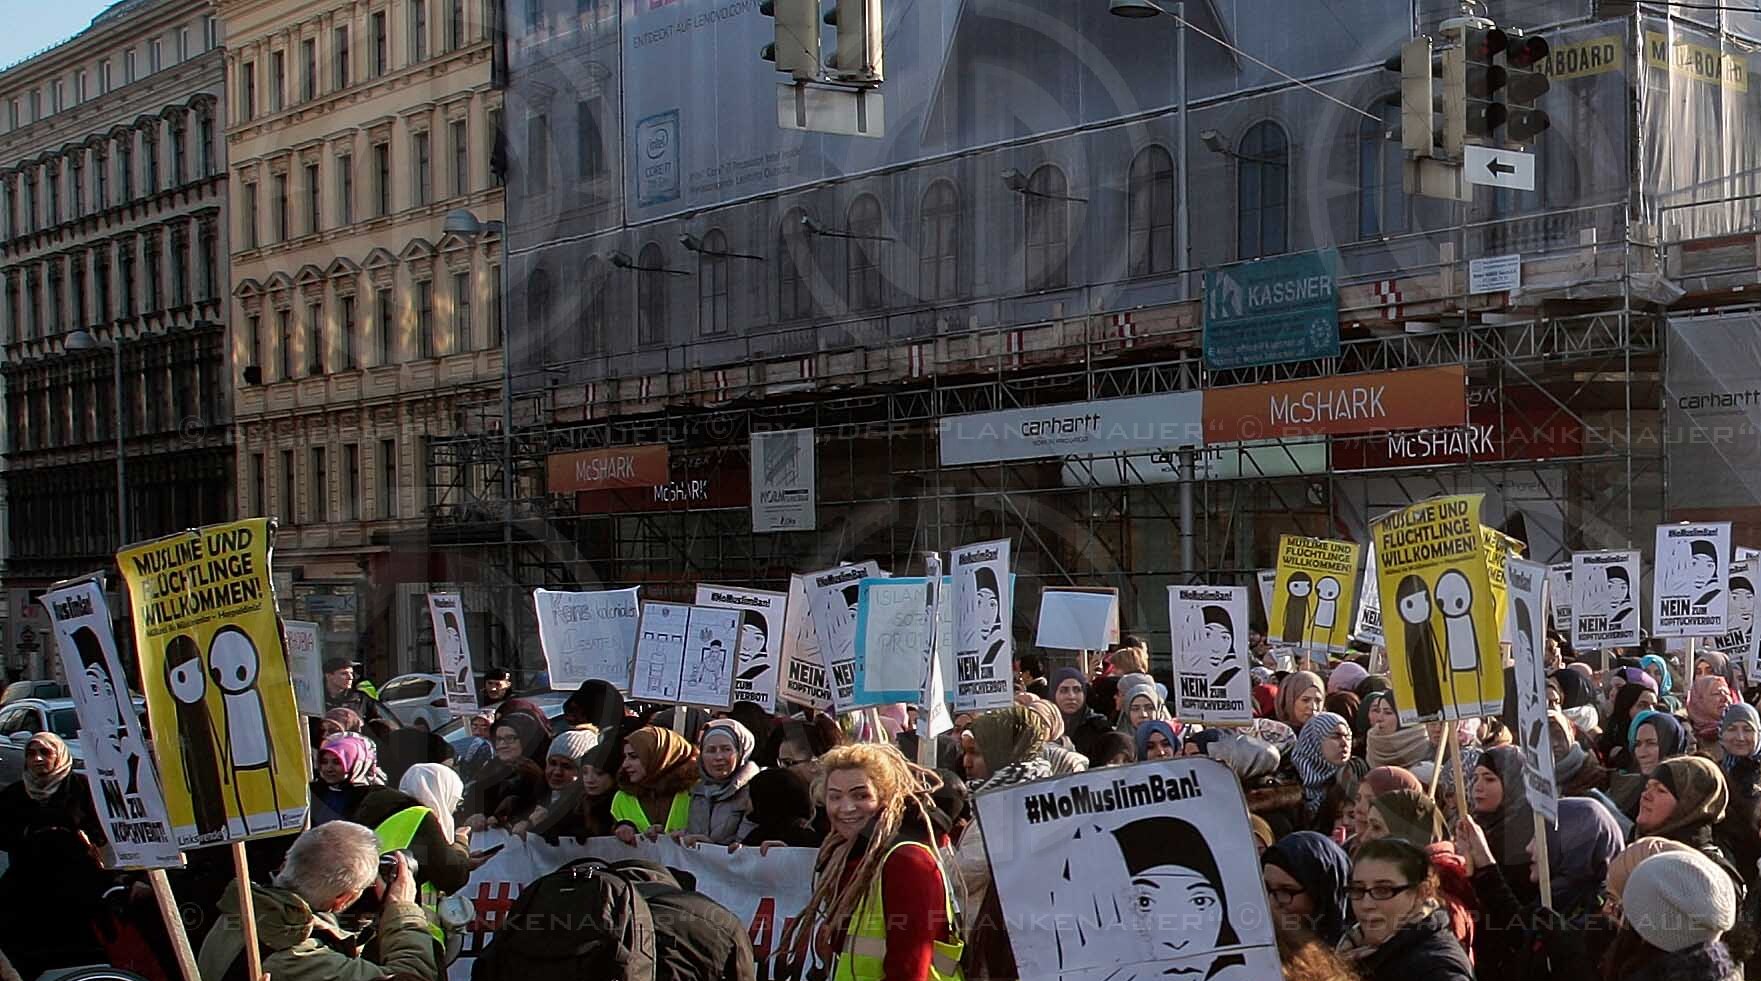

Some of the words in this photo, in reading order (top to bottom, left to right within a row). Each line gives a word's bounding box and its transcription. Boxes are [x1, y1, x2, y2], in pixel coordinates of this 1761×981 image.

[1248, 276, 1332, 308] KASSNER
[1270, 386, 1386, 425] McSHARK
[1678, 390, 1761, 410] carhartt
[1022, 413, 1100, 437] carhartt
[1388, 425, 1495, 458] McSHARK
[576, 456, 635, 481] McSHARK
[1438, 500, 1468, 519] UND
[133, 539, 204, 577] MUSLIME
[207, 528, 253, 557] UND
[1330, 543, 1352, 554] UND
[1381, 537, 1477, 568] WILLKOMMEN!
[142, 577, 264, 627] WILLKOMMEN!
[1660, 599, 1691, 617] NEIN
[1578, 617, 1608, 633] NEIN
[1714, 630, 1744, 648] NEIN
[789, 662, 825, 687] NEIN
[957, 656, 979, 681] NEIN
[1180, 677, 1208, 699] NEIN
[1025, 770, 1203, 825] #NoMuslimBan!
